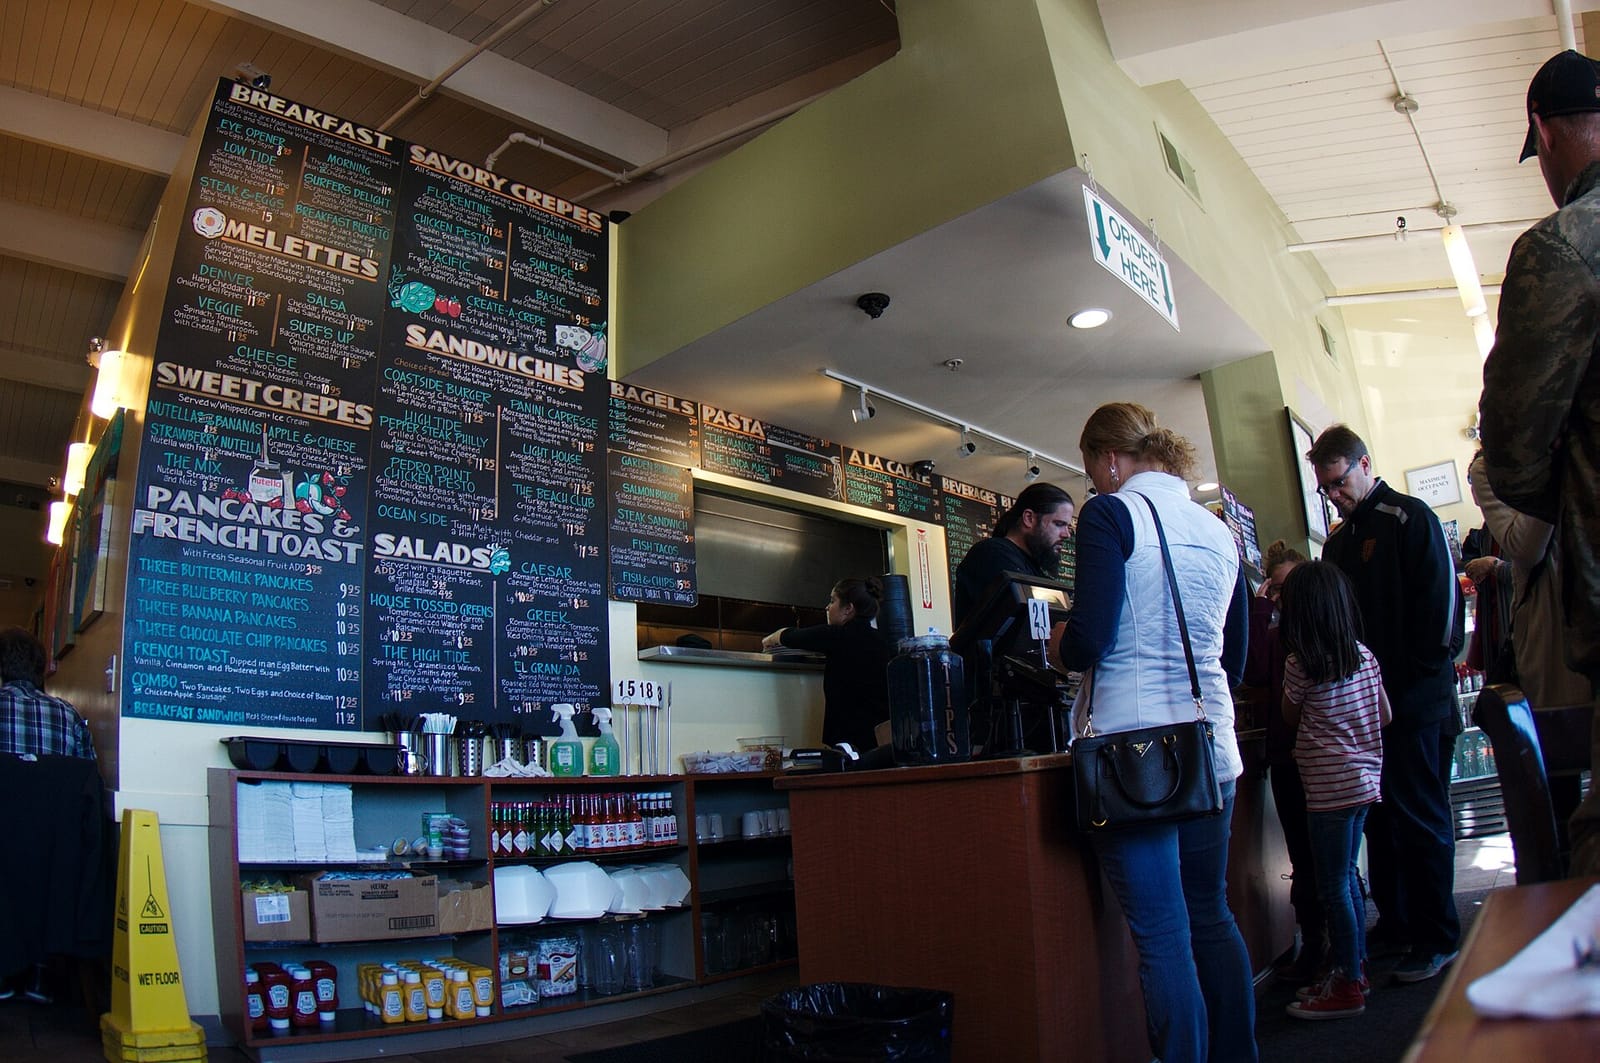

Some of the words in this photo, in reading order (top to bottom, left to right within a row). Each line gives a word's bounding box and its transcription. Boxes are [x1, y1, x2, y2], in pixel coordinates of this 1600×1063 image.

[230, 81, 392, 152] BREAKFAST
[220, 118, 244, 134] EYE
[245, 126, 286, 148] OPENER
[223, 140, 247, 157] LOW
[249, 148, 277, 167] TIDE
[327, 152, 370, 175] MORNING
[199, 175, 237, 194] STEAK
[255, 192, 284, 208] EGGS
[303, 172, 350, 195] SURFERS
[354, 188, 391, 208] DELIGHT
[409, 144, 508, 194] SAVORY
[510, 180, 601, 229] CREPES
[426, 185, 492, 216] FLORENTINE
[261, 210, 272, 223] 15
[295, 202, 350, 228] BREAKFAST
[352, 220, 389, 240] BURRITO
[413, 212, 452, 233] CHICKEN
[456, 225, 490, 245] PESTO
[537, 224, 572, 245] ITALIAN
[1109, 216, 1159, 277] ORDER
[427, 250, 471, 272] PACIFIC
[529, 257, 549, 272] SUN
[552, 264, 573, 279] RISE
[199, 263, 254, 288] DENVER
[1121, 252, 1159, 304] HERE
[197, 295, 244, 318] VEGGIE
[306, 292, 347, 312] SALSA
[466, 294, 545, 325] CREATE-A-CREPE
[536, 289, 565, 306] BASIC
[460, 313, 478, 324] Each
[480, 319, 513, 334] Additional
[466, 306, 488, 318] Start
[289, 318, 334, 340] SURF'S
[336, 330, 355, 345] UP
[235, 344, 297, 369] CHEESE
[154, 360, 263, 404] SWEET
[262, 383, 373, 427] CREPES
[383, 366, 442, 390] COASTSIDE
[445, 382, 491, 404] BURGER
[610, 381, 695, 416] BAGELS
[148, 400, 198, 423] NUTELLA
[214, 413, 262, 436] BANANAS
[404, 410, 431, 425] HIGH
[434, 416, 462, 432] TIDE
[510, 399, 544, 415] PANINI
[547, 407, 598, 429] CAPRESSE
[702, 405, 765, 437] PASTA
[150, 422, 219, 447] STRAWBERRY
[220, 436, 262, 455] NUTELLA
[268, 425, 299, 442] APPLE
[317, 435, 357, 454] CHEESE
[379, 415, 420, 432] PEPPER
[421, 424, 452, 440] STEAK
[454, 431, 488, 448] PHILLY
[162, 452, 196, 470] THE
[198, 458, 222, 475] MIX
[522, 444, 547, 458] LIGHT
[551, 450, 582, 464] HOUSE
[849, 449, 862, 465] A
[864, 453, 883, 471] LA
[383, 466, 432, 484] CHICKEN
[437, 476, 476, 492] PESTO
[390, 457, 431, 474] PEDRO
[433, 464, 471, 481] POINT
[512, 483, 532, 496] THE
[536, 488, 567, 502] BEACH
[569, 493, 594, 507] CLUB
[942, 477, 997, 504] BEVERAGES
[145, 486, 325, 535] PANCAKES
[331, 516, 360, 539] &
[376, 504, 416, 522] OCEAN
[419, 511, 447, 526] SIDE
[617, 509, 646, 521] STEAK
[648, 514, 688, 530] SANDWICH
[131, 509, 259, 551] FRENCH
[260, 528, 363, 566] TOAST
[373, 533, 492, 567] SALADS
[632, 539, 652, 550] FISH
[654, 543, 679, 554] TACOS
[182, 547, 201, 558] With
[202, 550, 226, 560] Fresh
[227, 553, 265, 566] Seasonal
[267, 559, 287, 570] Fruit
[289, 562, 305, 572] ADD
[374, 565, 395, 575] ADD
[521, 561, 571, 578] CAESAR
[137, 557, 178, 574] THREE
[254, 573, 312, 592] PANCAKES
[623, 572, 641, 583] FISH
[652, 575, 674, 587] CHIPS
[136, 578, 183, 596] THREE
[184, 584, 247, 604] BLUEBERRY
[251, 592, 309, 611] PANCAKES
[370, 593, 410, 607] HOUSE
[413, 597, 457, 612] TOSSED
[459, 603, 493, 617] GREENS
[135, 598, 178, 617] THREE
[180, 604, 231, 623] BANANA
[234, 611, 297, 629] PANCAKES
[526, 608, 570, 623] GREEK
[1033, 602, 1047, 628] 21
[134, 618, 178, 638] THREE
[179, 624, 243, 645] CHOCOLATE
[245, 632, 271, 648] CHIP
[273, 636, 328, 653] PANCAKES
[132, 641, 183, 660] FRENCH
[187, 646, 230, 663] TOAST
[229, 657, 256, 667] Dipped
[165, 659, 204, 671] Cinnamon
[381, 645, 407, 659] THE
[412, 647, 440, 661] HIGH
[443, 649, 470, 663] TIDE
[514, 660, 527, 673] EL
[131, 671, 178, 689] COMBO
[235, 686, 250, 695] Two
[250, 687, 268, 697] Eggs
[618, 680, 635, 697] 15
[639, 682, 653, 698] 18
[132, 702, 195, 718] BREAKFAST
[195, 707, 245, 722] SANDWICH
[141, 924, 167, 933] CAUTION
[138, 972, 153, 986] WET
[155, 971, 180, 985] FLOOR
